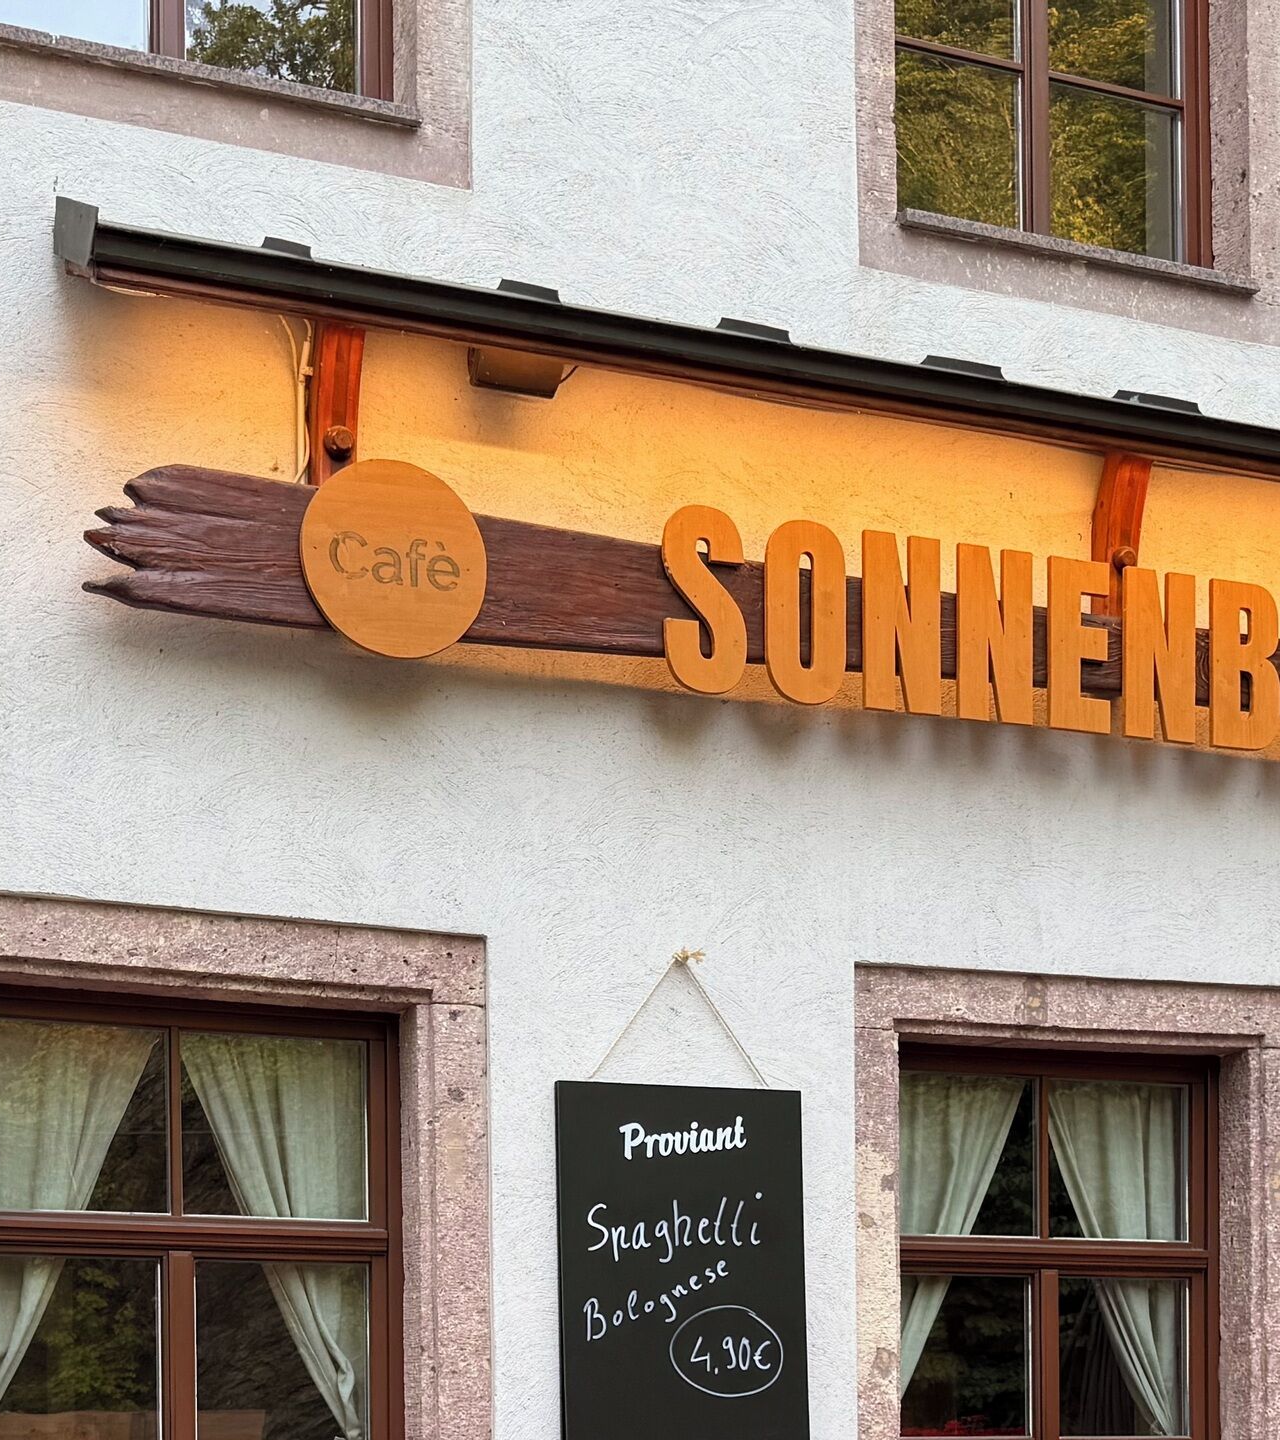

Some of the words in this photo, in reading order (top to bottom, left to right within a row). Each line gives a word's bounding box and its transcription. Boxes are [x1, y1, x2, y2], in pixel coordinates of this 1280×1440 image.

[619, 1116, 747, 1160] Proviant
[586, 1192, 763, 1264] Spaghetti
[583, 1259, 729, 1342] Bolognese
